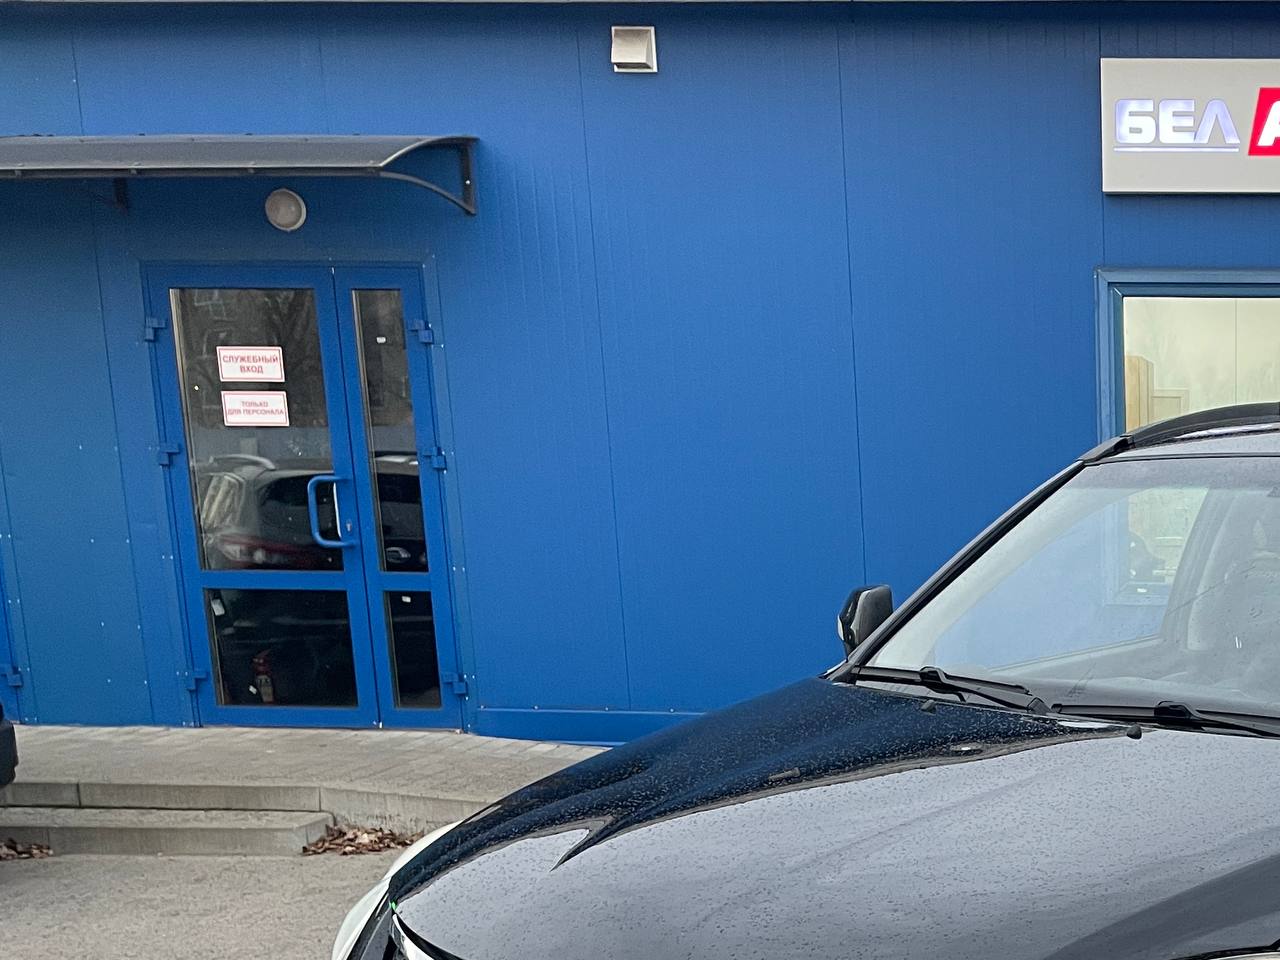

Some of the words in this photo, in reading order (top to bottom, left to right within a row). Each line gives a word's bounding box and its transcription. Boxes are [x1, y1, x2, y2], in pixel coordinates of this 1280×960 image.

[1113, 99, 1241, 145] БЕЛ
[222, 354, 279, 364] СЛУЖЕБНЫЙ
[240, 365, 264, 374] ВХОД
